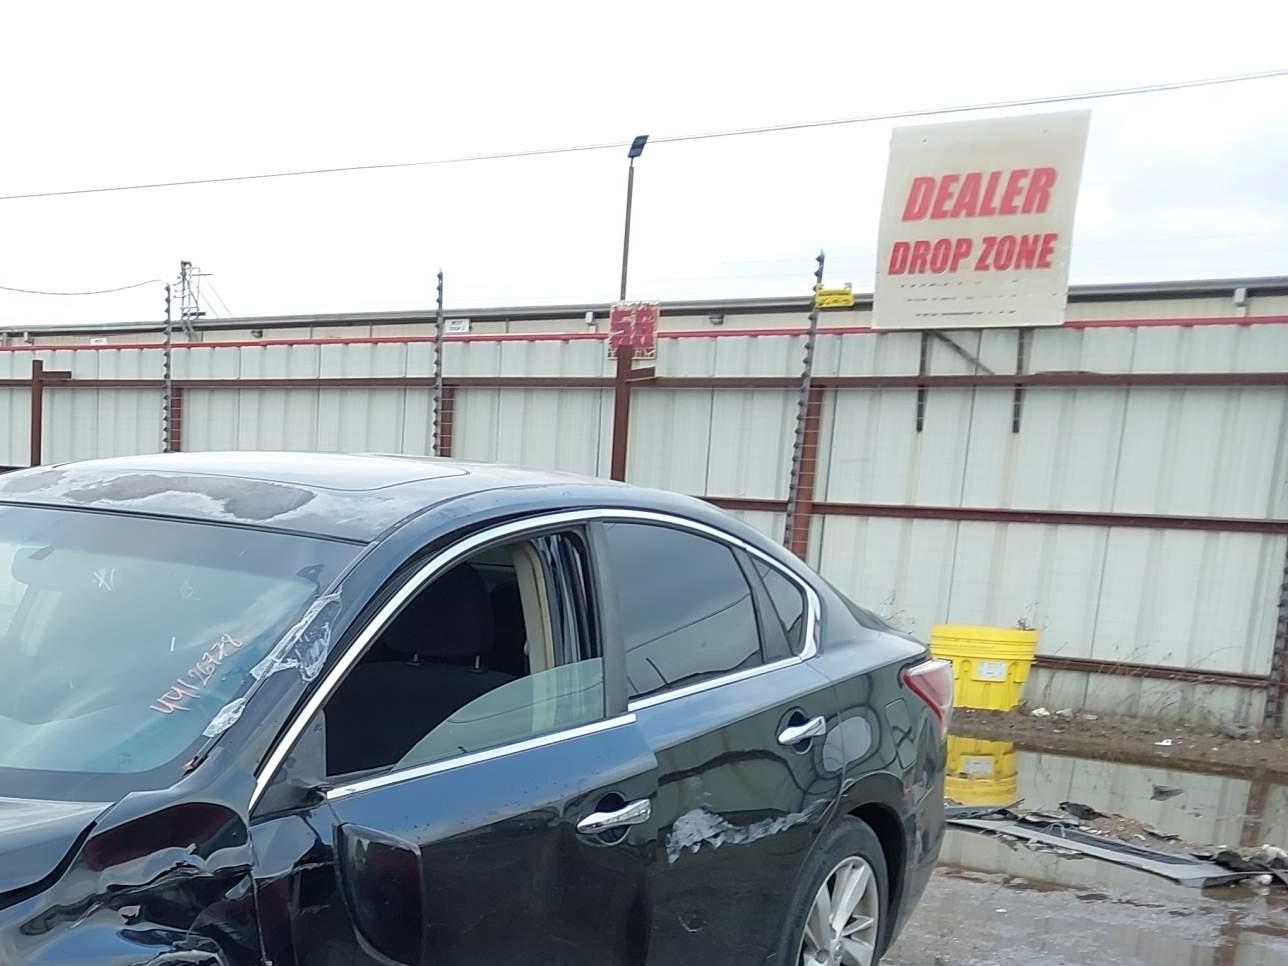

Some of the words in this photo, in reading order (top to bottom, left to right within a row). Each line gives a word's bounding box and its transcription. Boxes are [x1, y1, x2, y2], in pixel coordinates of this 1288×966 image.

[902, 167, 1059, 222] DEALER
[887, 238, 973, 276] DROP
[974, 233, 1059, 272] ZONE
